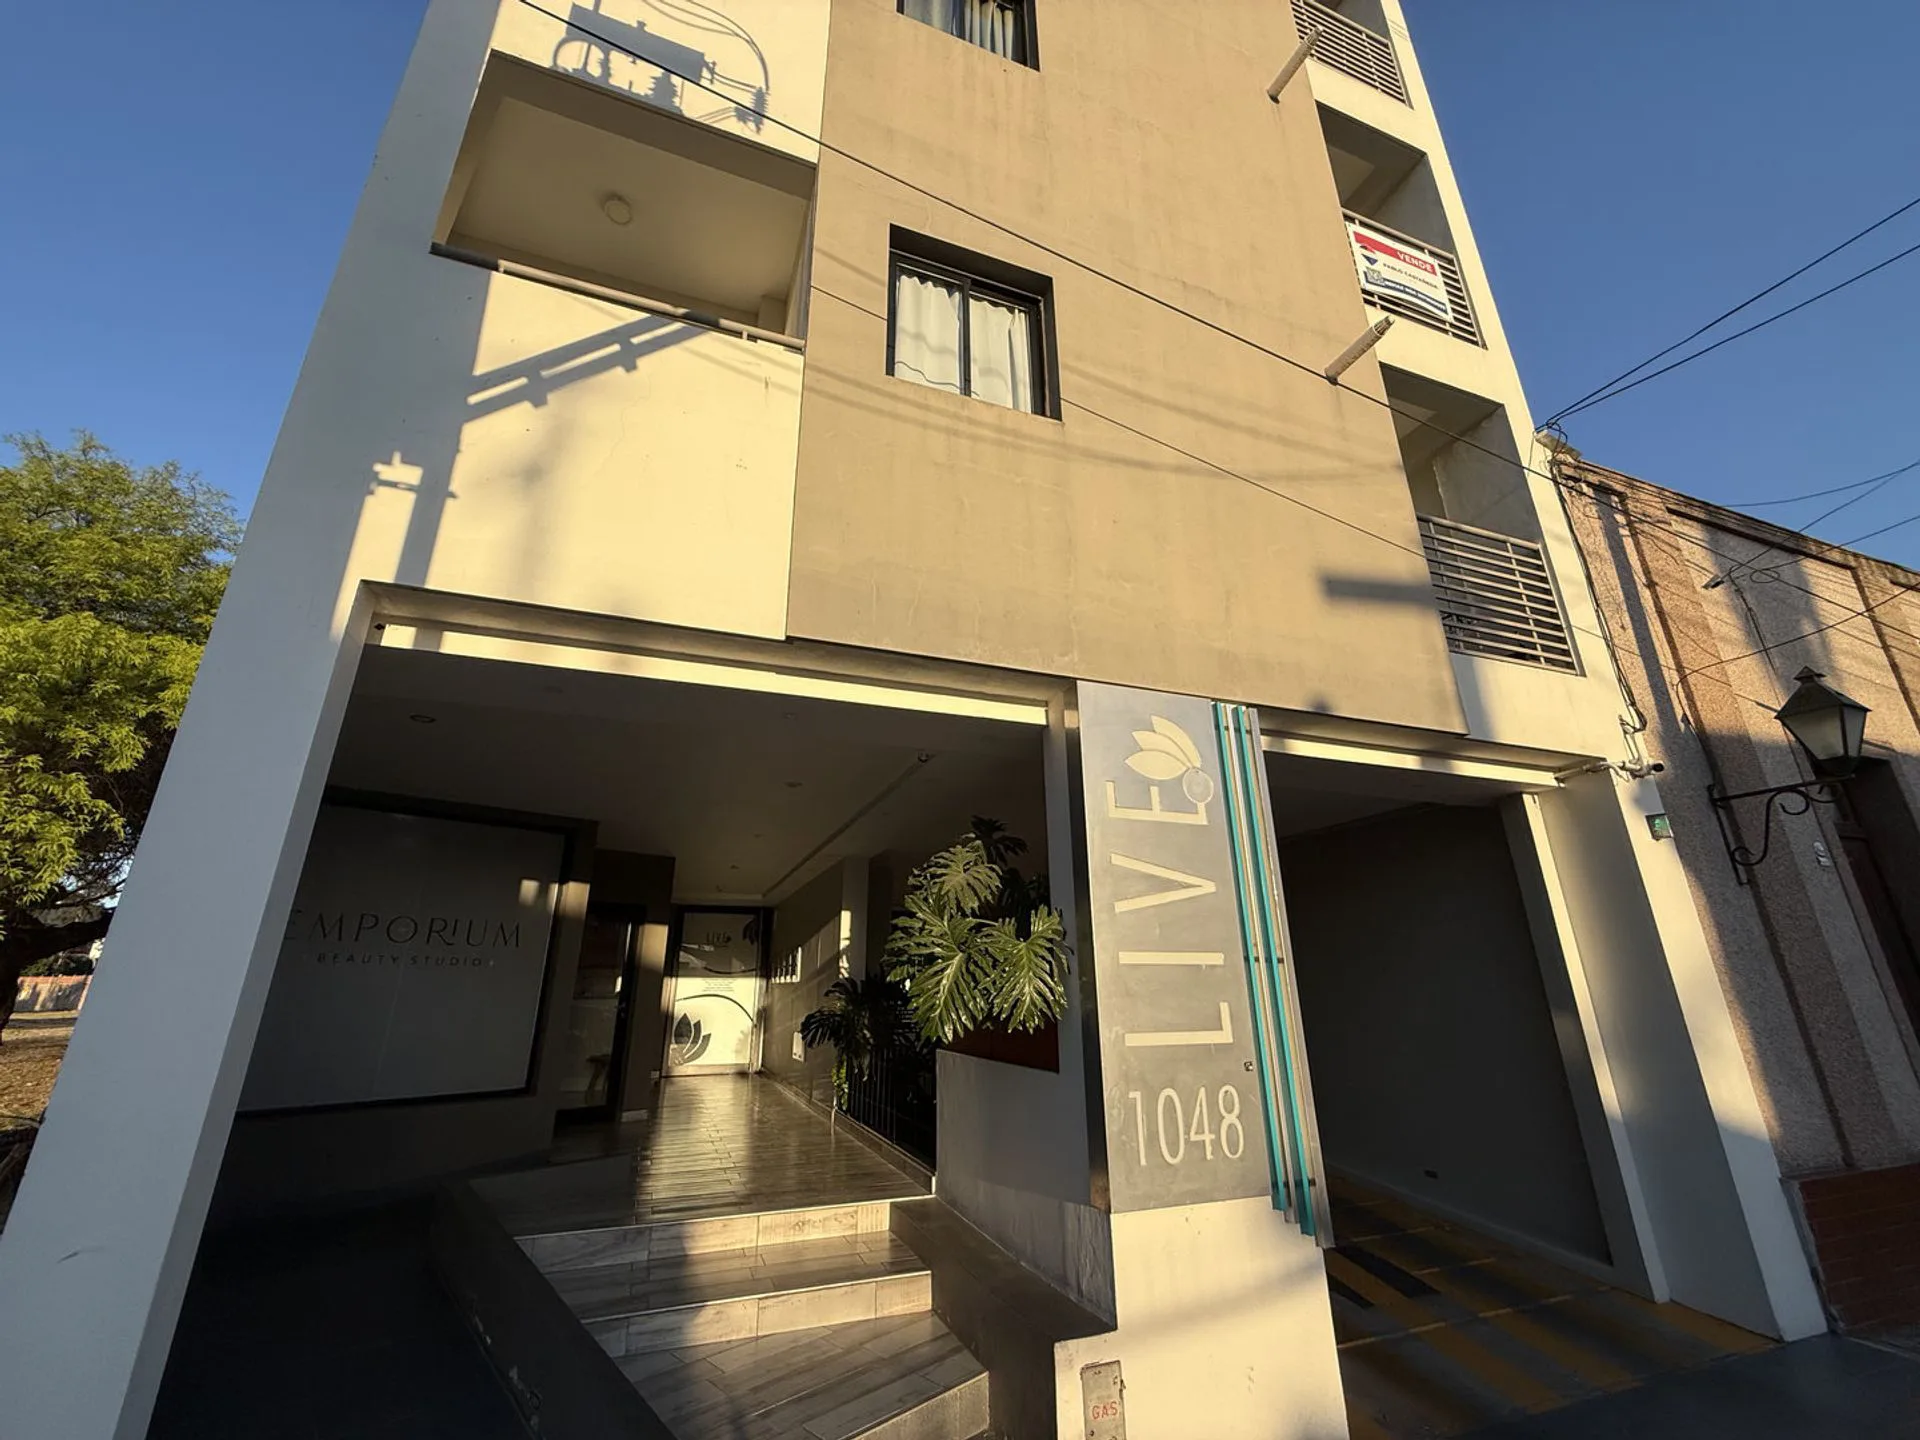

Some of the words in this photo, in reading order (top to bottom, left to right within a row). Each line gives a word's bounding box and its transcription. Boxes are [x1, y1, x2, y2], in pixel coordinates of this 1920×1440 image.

[1397, 251, 1433, 272] VENDE
[1106, 779, 1234, 1046] LIVE
[317, 953, 399, 965] BEAUTY
[410, 955, 483, 967] STUDIO
[1128, 1083, 1244, 1167] 1048
[1091, 1401, 1118, 1420] GAS
